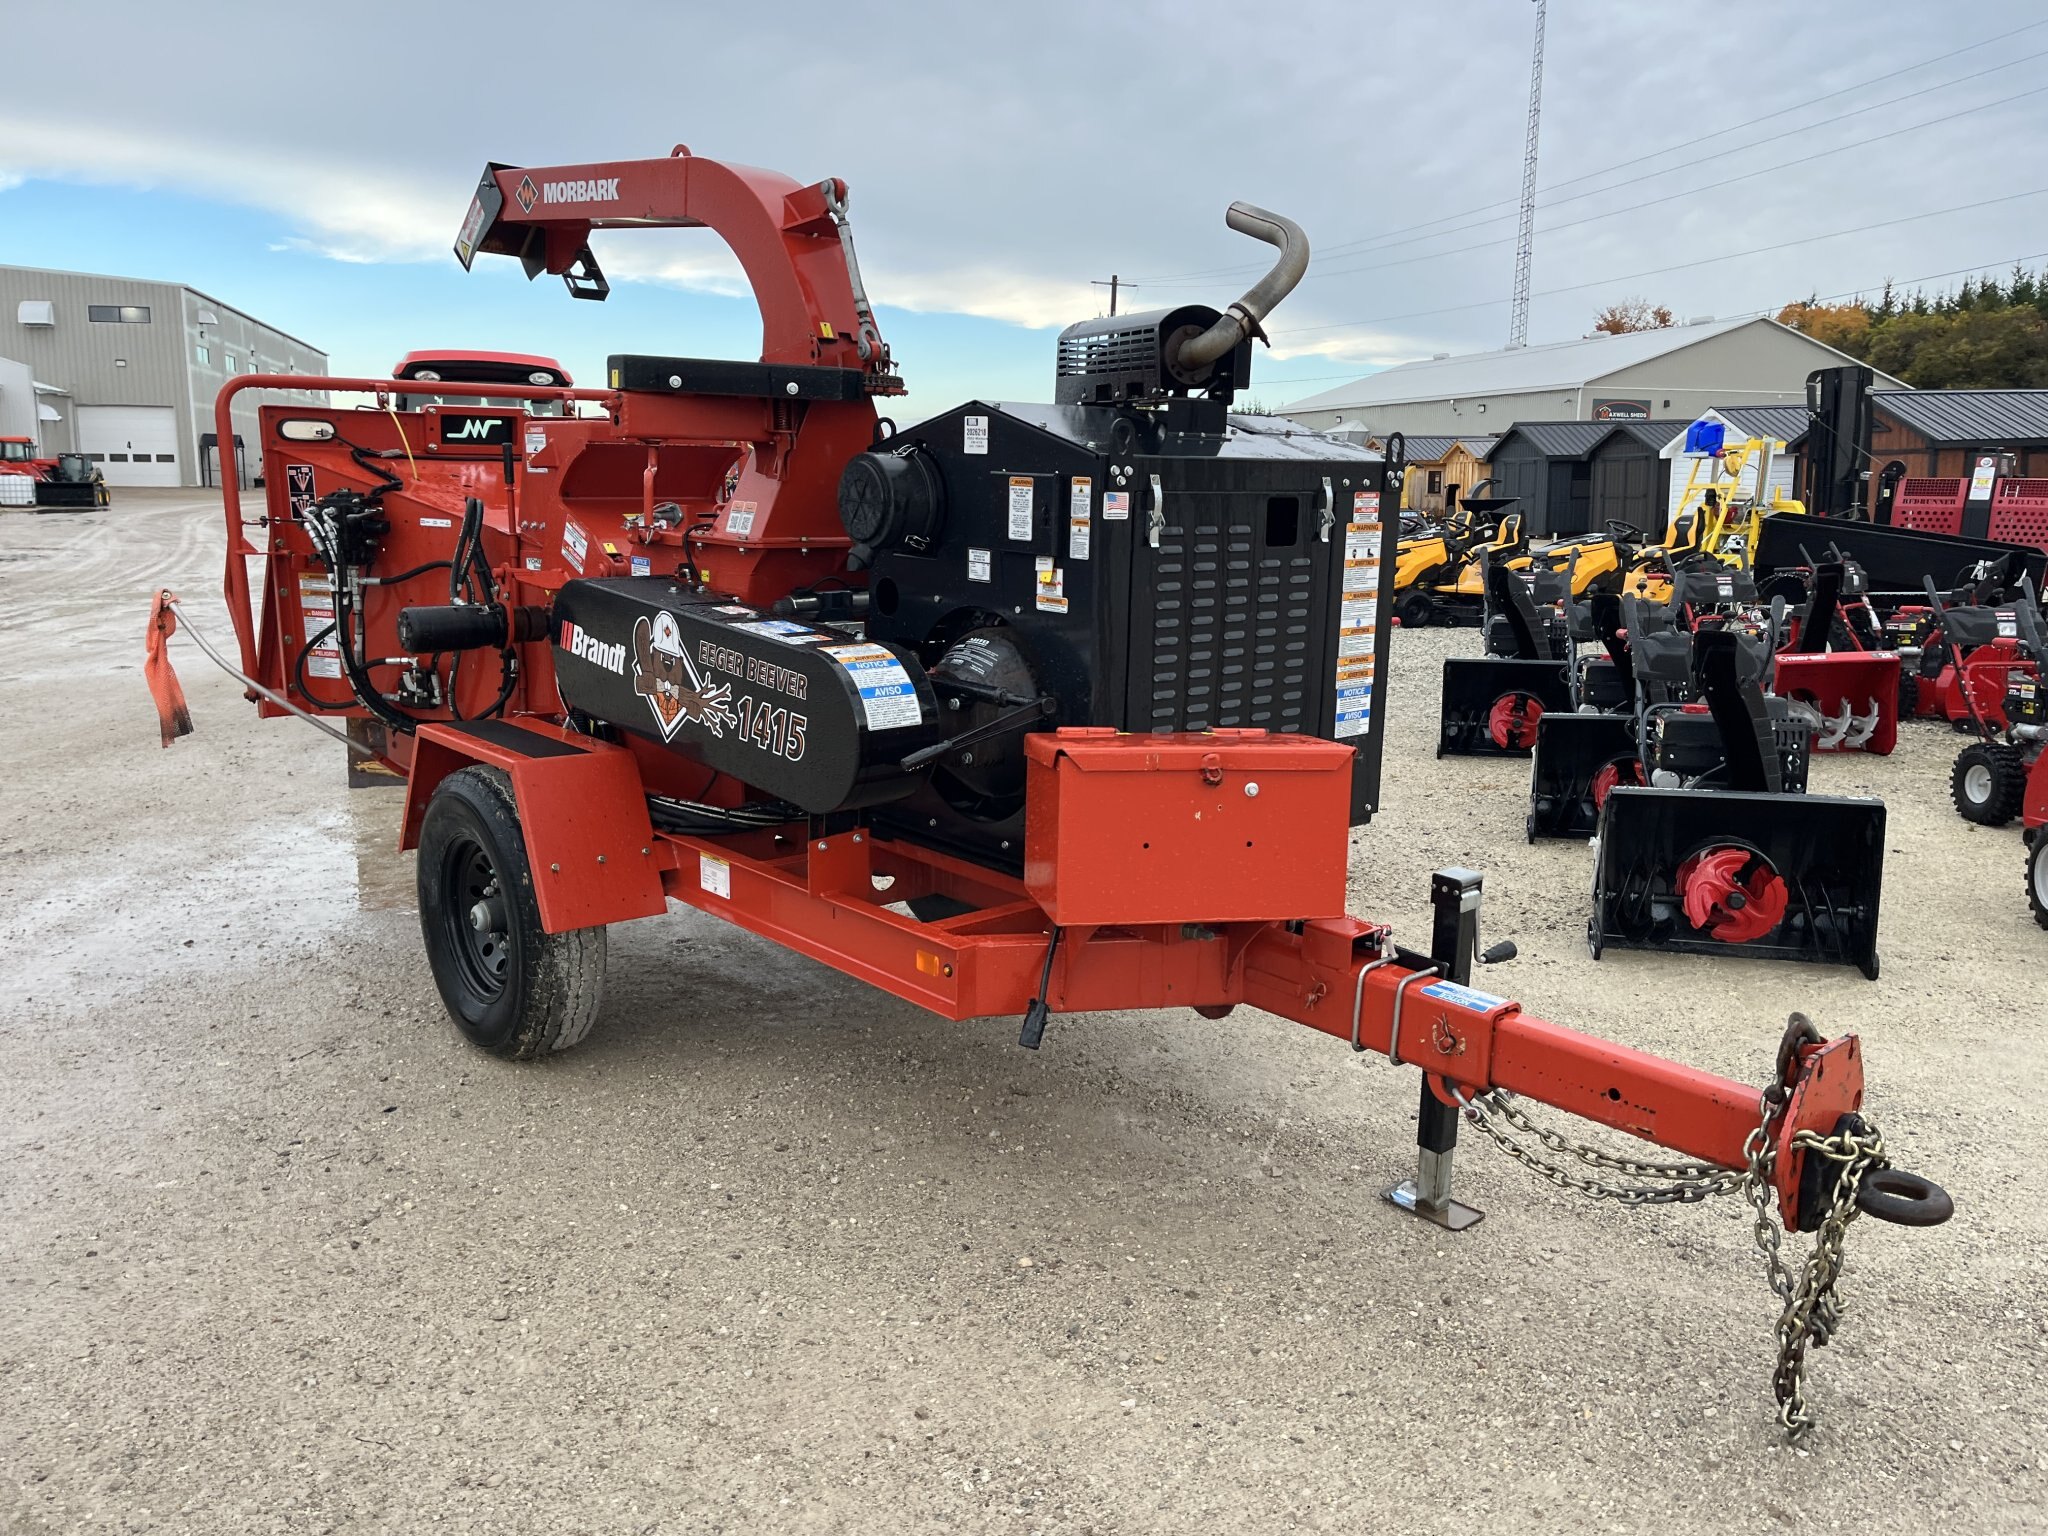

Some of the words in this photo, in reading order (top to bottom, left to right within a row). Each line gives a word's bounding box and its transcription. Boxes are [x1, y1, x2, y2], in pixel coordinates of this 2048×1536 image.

[543, 178, 620, 204] MORBARK
[315, 650, 337, 658] PELIGRO
[571, 624, 628, 676] Brandt
[698, 639, 744, 678] EEGER
[747, 656, 809, 701] BEEVER
[856, 660, 890, 669] NOTICE
[874, 685, 902, 697] AVISO
[1343, 687, 1365, 697] NOTICE
[1343, 711, 1363, 720] AVISO
[737, 695, 808, 762] 1415
